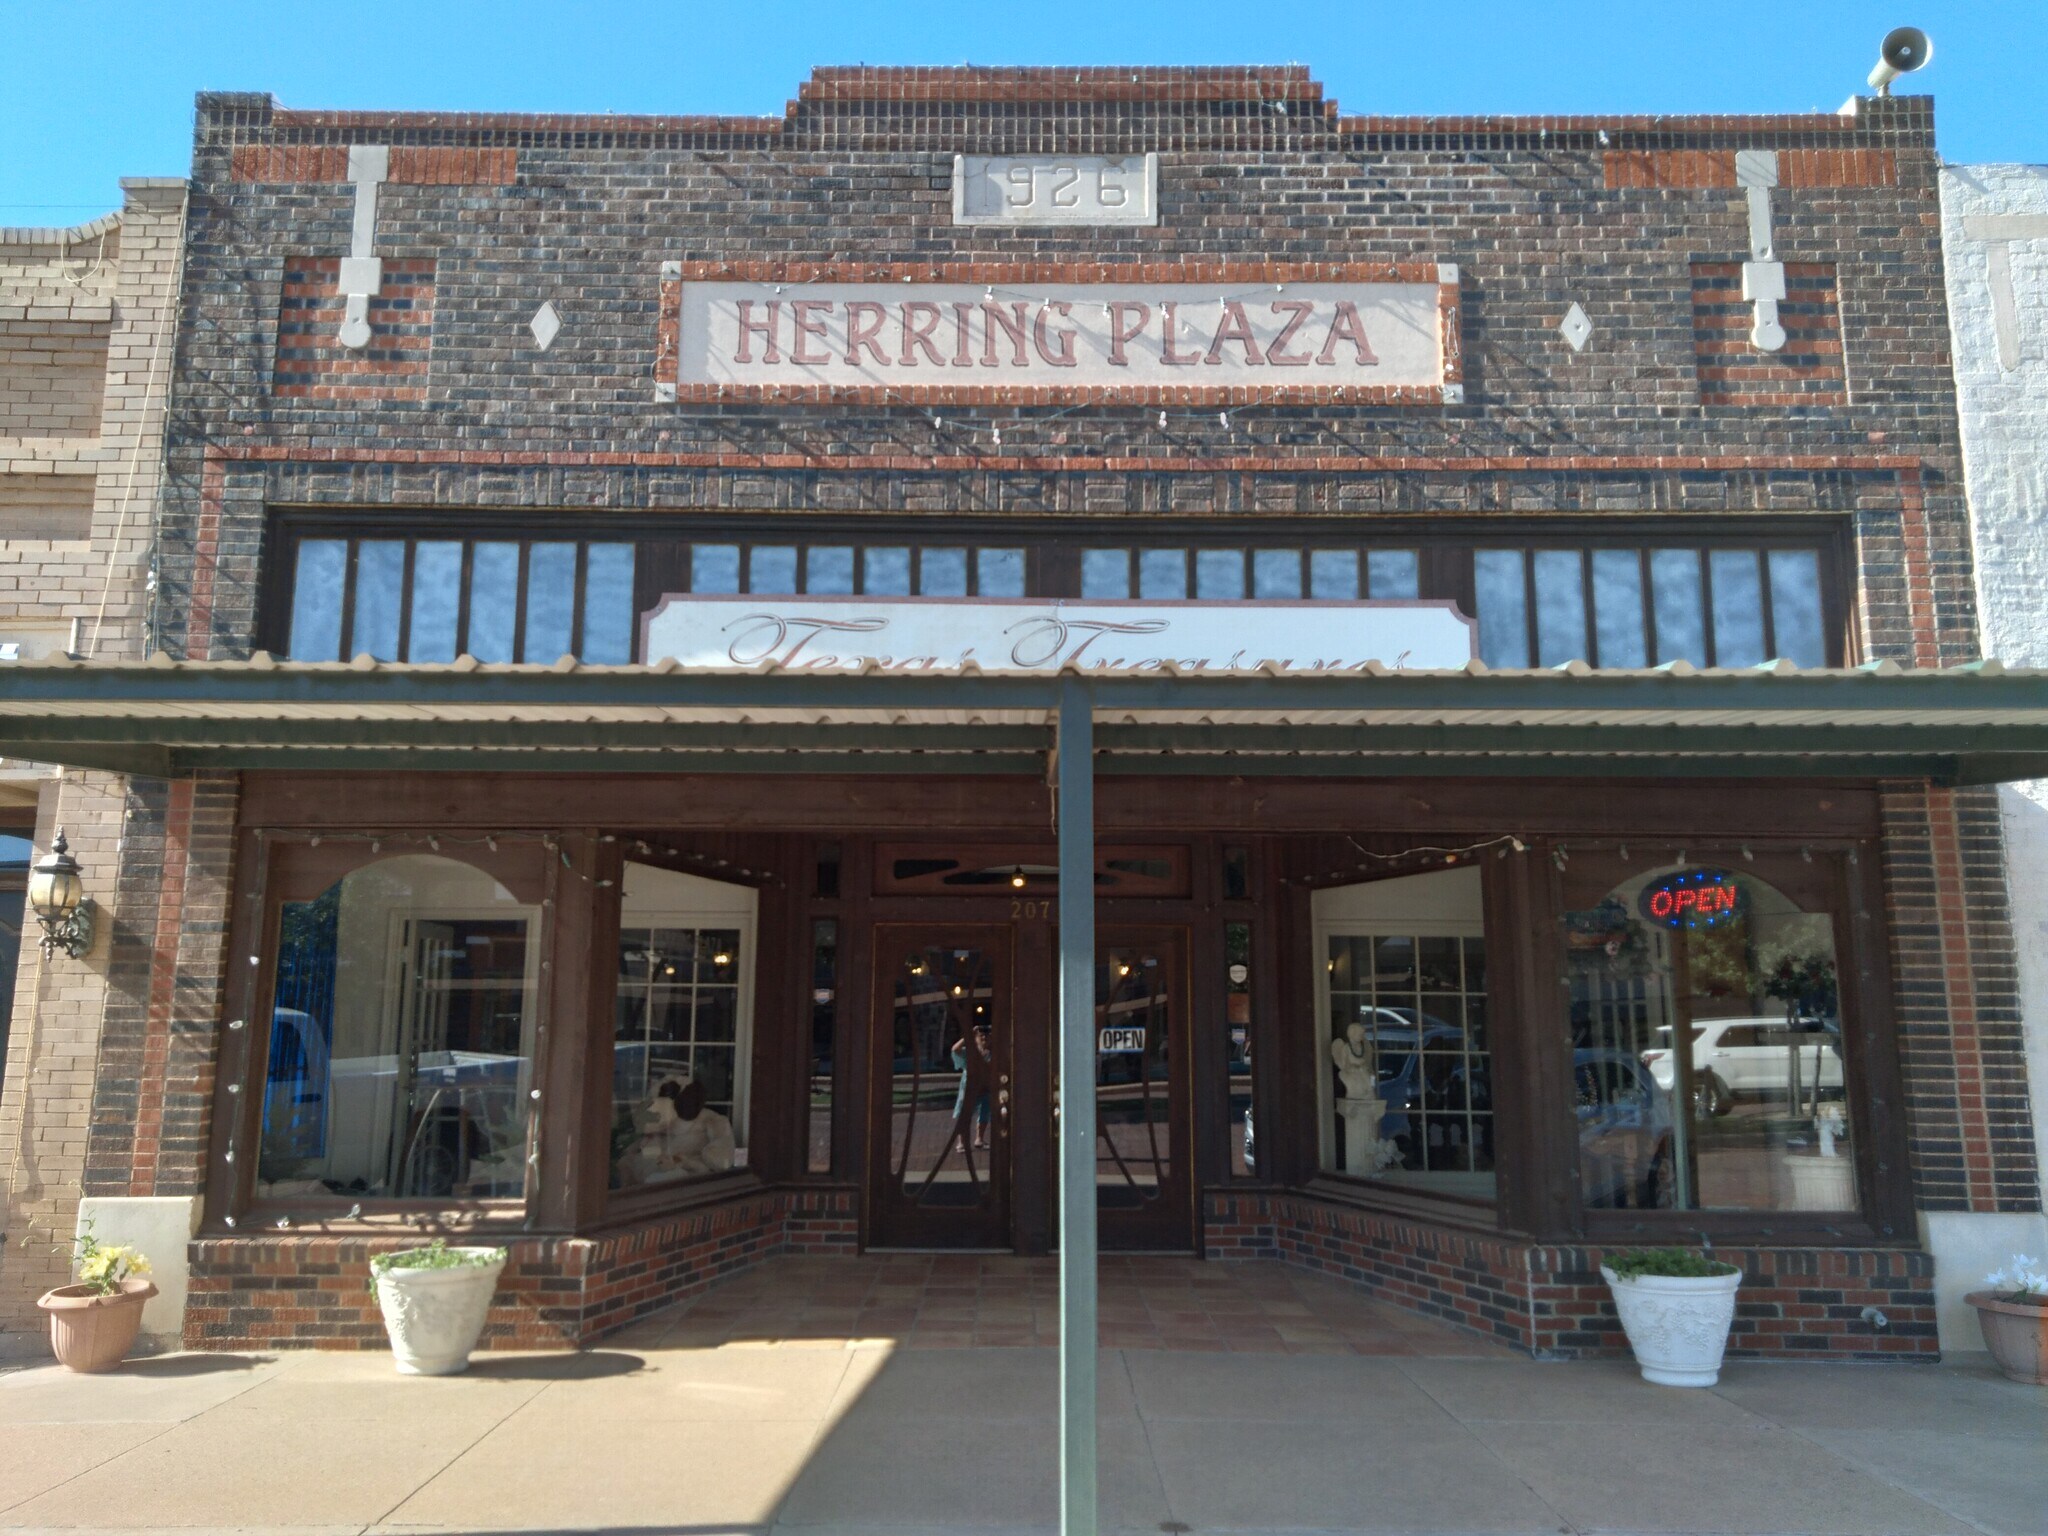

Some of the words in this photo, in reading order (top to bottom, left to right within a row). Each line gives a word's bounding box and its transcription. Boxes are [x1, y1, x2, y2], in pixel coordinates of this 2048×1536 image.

[733, 298, 1077, 368] HERRING
[1107, 300, 1380, 368] PLAZA
[1010, 901, 1051, 919] 207
[1651, 886, 1736, 917] OPEN
[1102, 1029, 1144, 1050] OPEN
